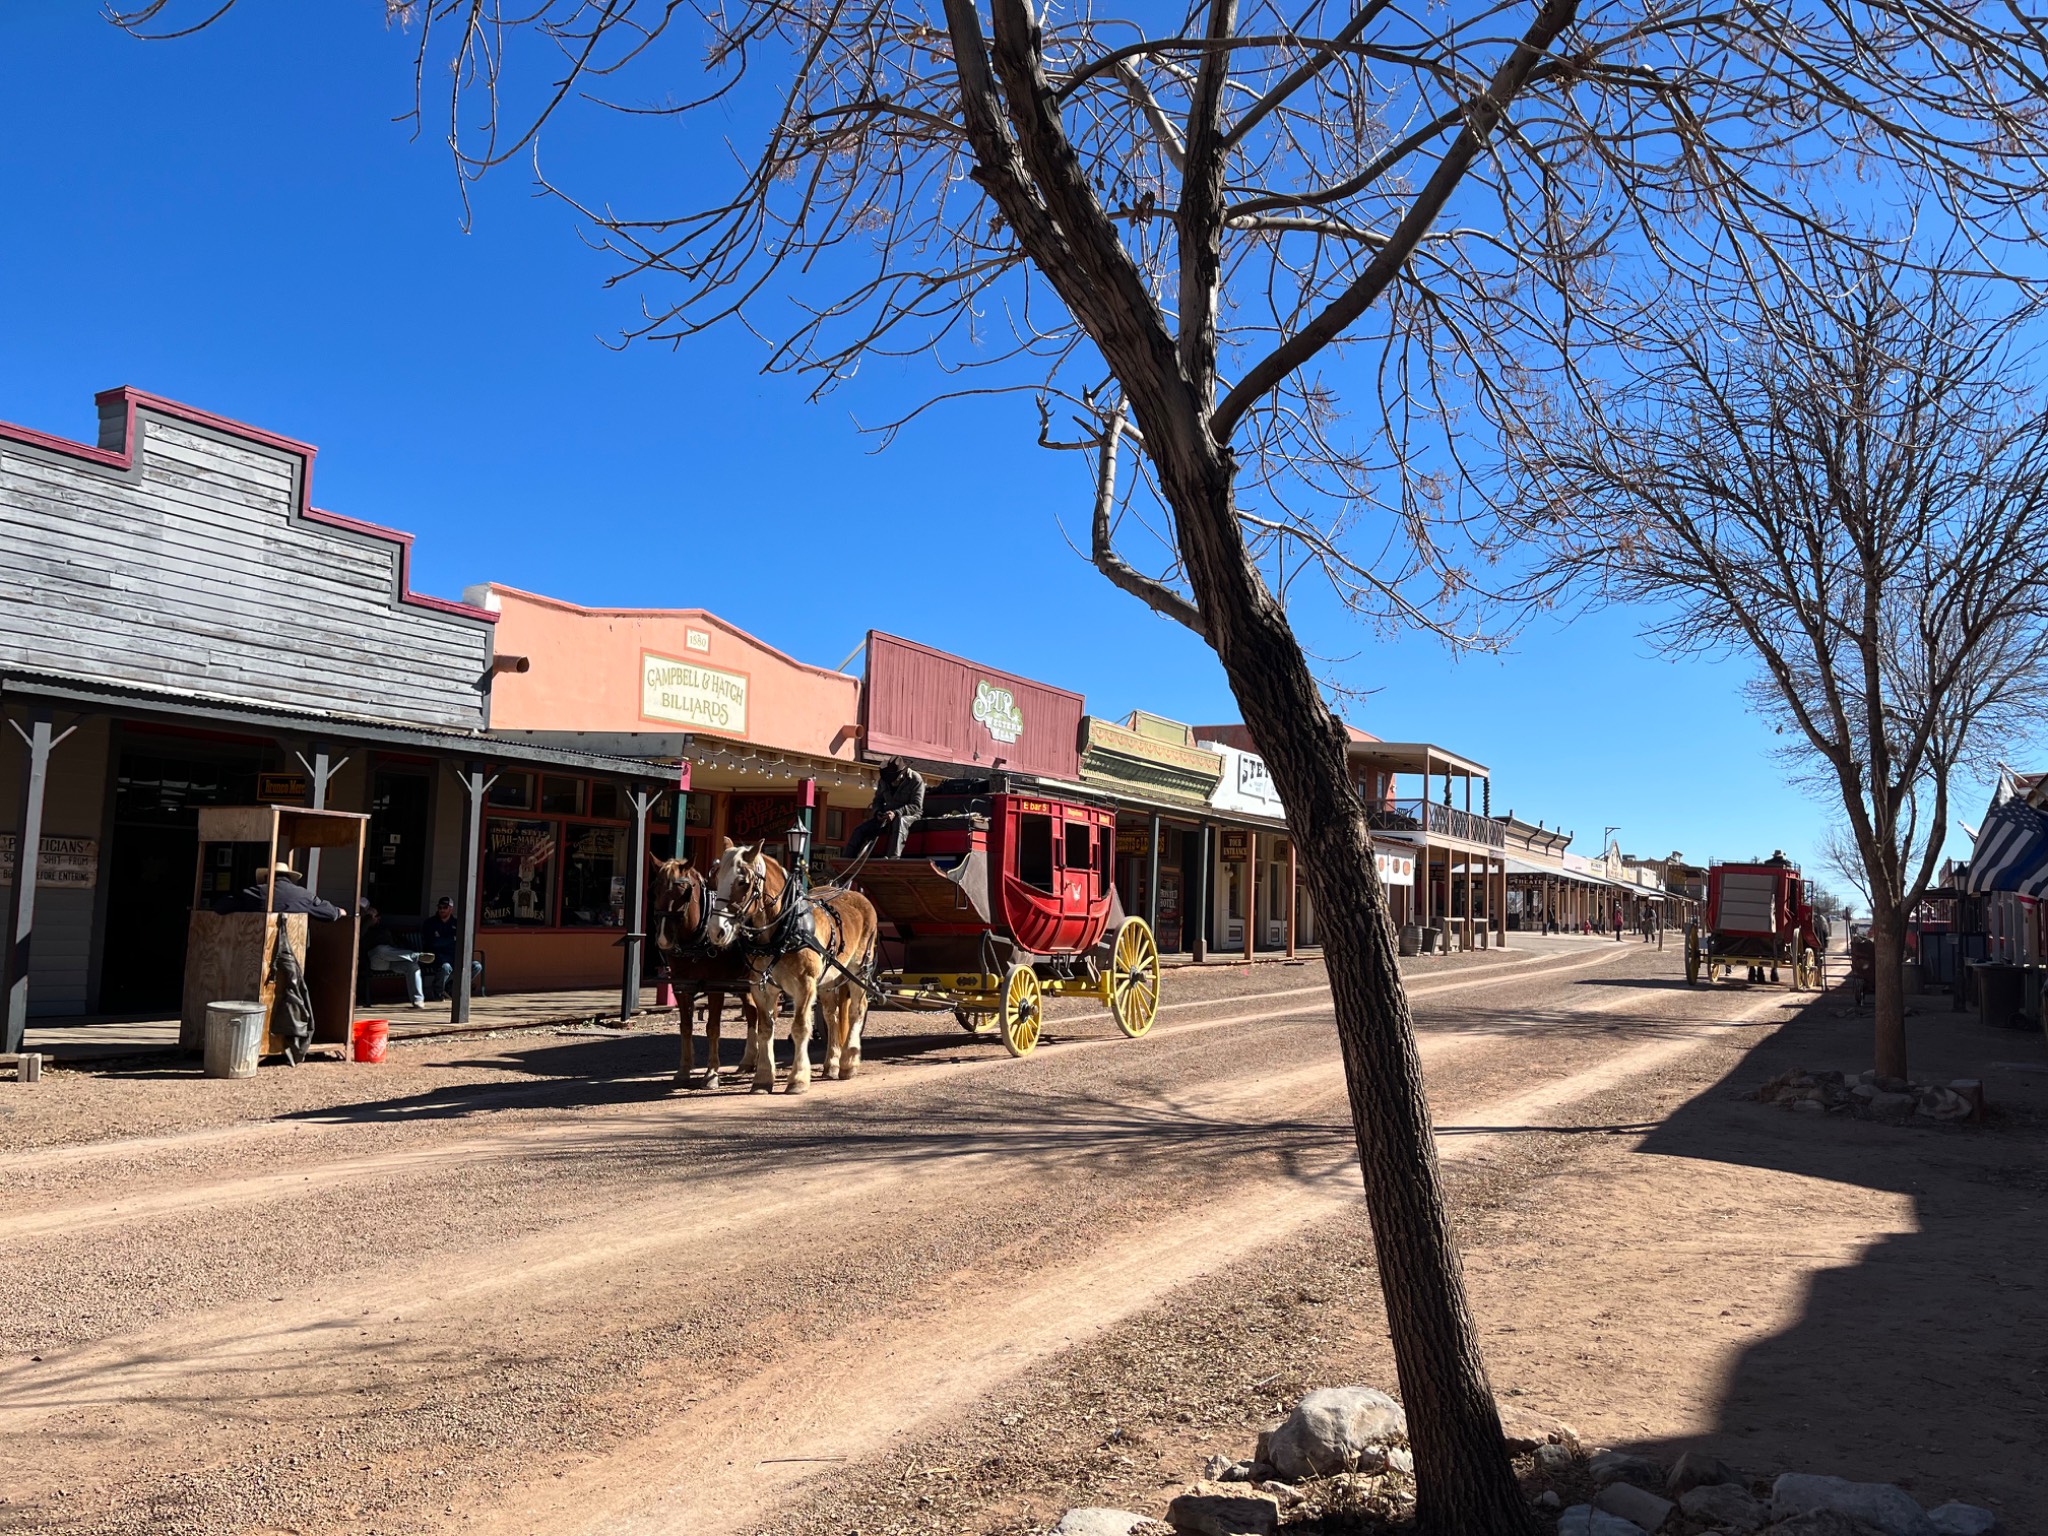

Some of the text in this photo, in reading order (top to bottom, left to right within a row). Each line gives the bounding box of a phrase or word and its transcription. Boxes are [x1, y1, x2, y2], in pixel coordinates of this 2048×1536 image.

[689, 634, 707, 648] 1880
[647, 667, 744, 706] CAMPBELL & HATCH
[974, 683, 1013, 719] SPUR
[662, 692, 729, 726] BILLIARDS
[1023, 801, 1029, 810] E
[1030, 803, 1042, 811] bar
